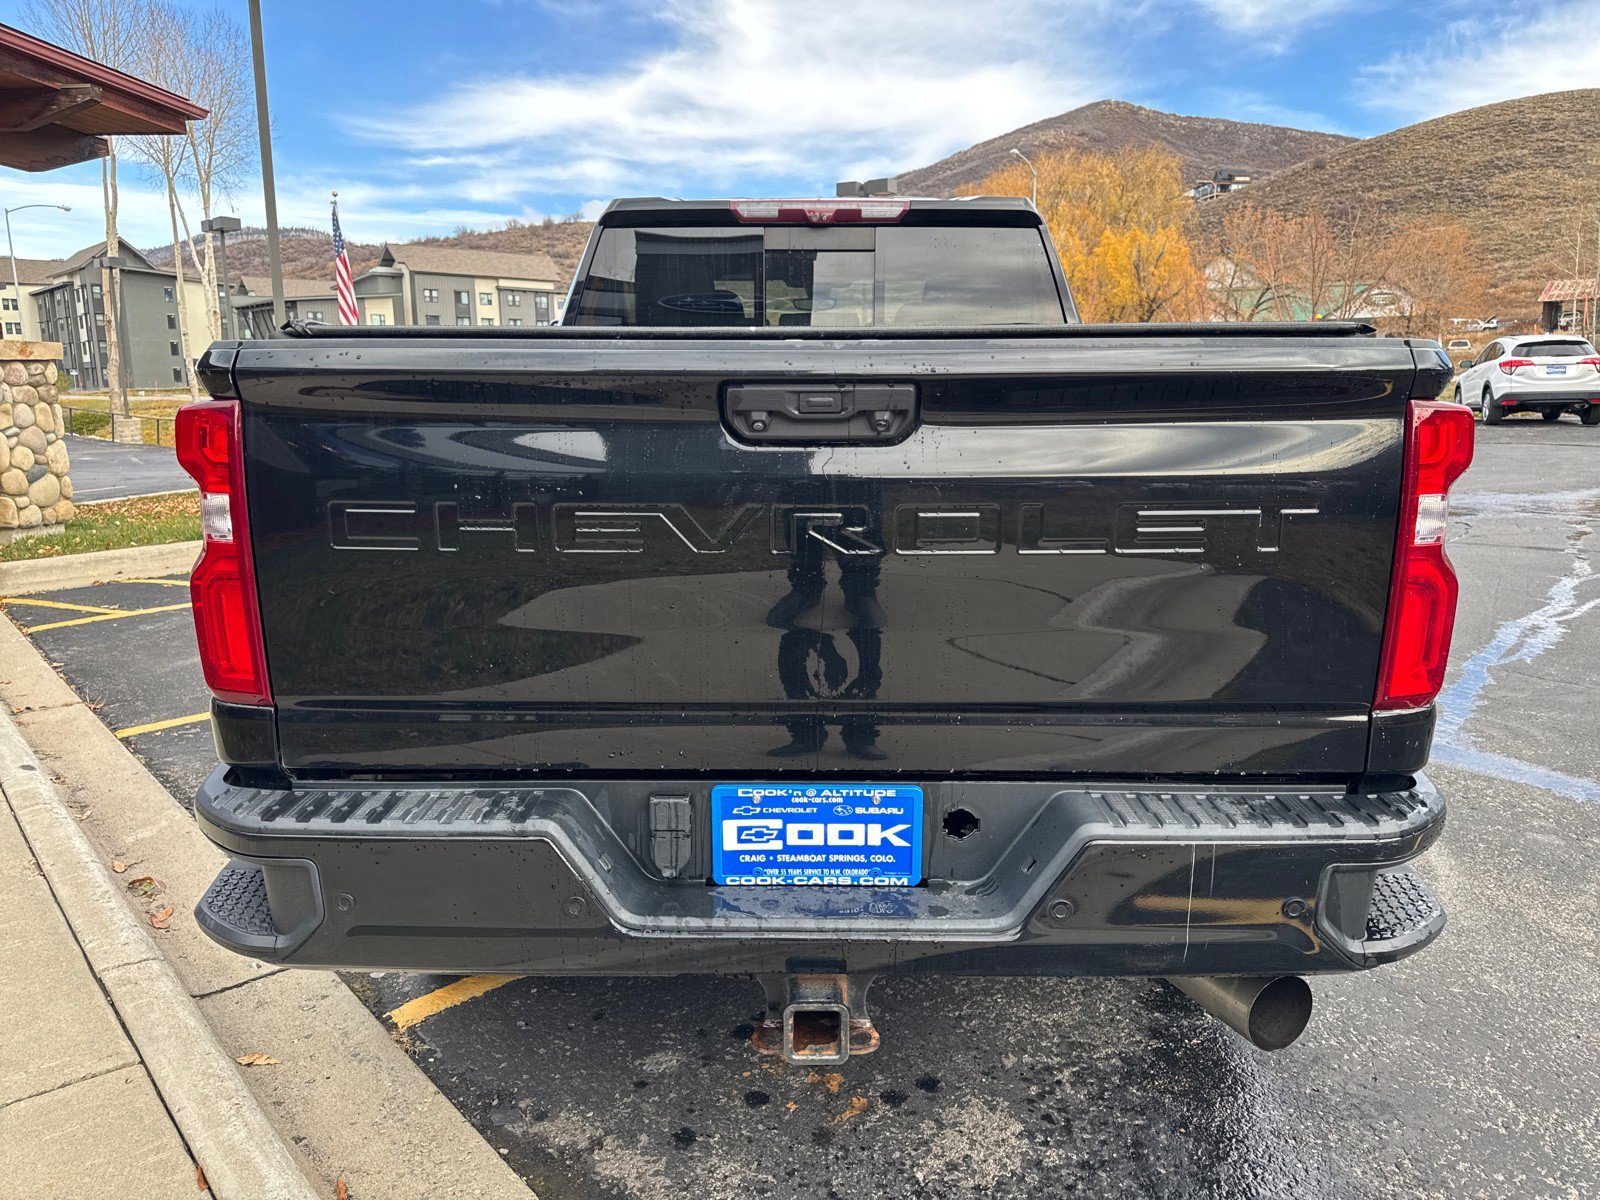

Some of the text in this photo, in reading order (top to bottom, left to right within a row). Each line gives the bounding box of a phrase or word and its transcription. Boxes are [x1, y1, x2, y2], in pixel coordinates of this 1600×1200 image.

[328, 500, 1319, 556] CHEVROLET
[820, 789, 897, 797] ALTITUDE
[791, 796, 844, 804] cook-cars.com
[854, 806, 904, 815] SUBARU
[722, 818, 912, 851] COOK
[739, 854, 896, 864] CRAIG STEAMBOAT SPRINGS, COLO.
[725, 876, 909, 886] COOK-CARS.COM
